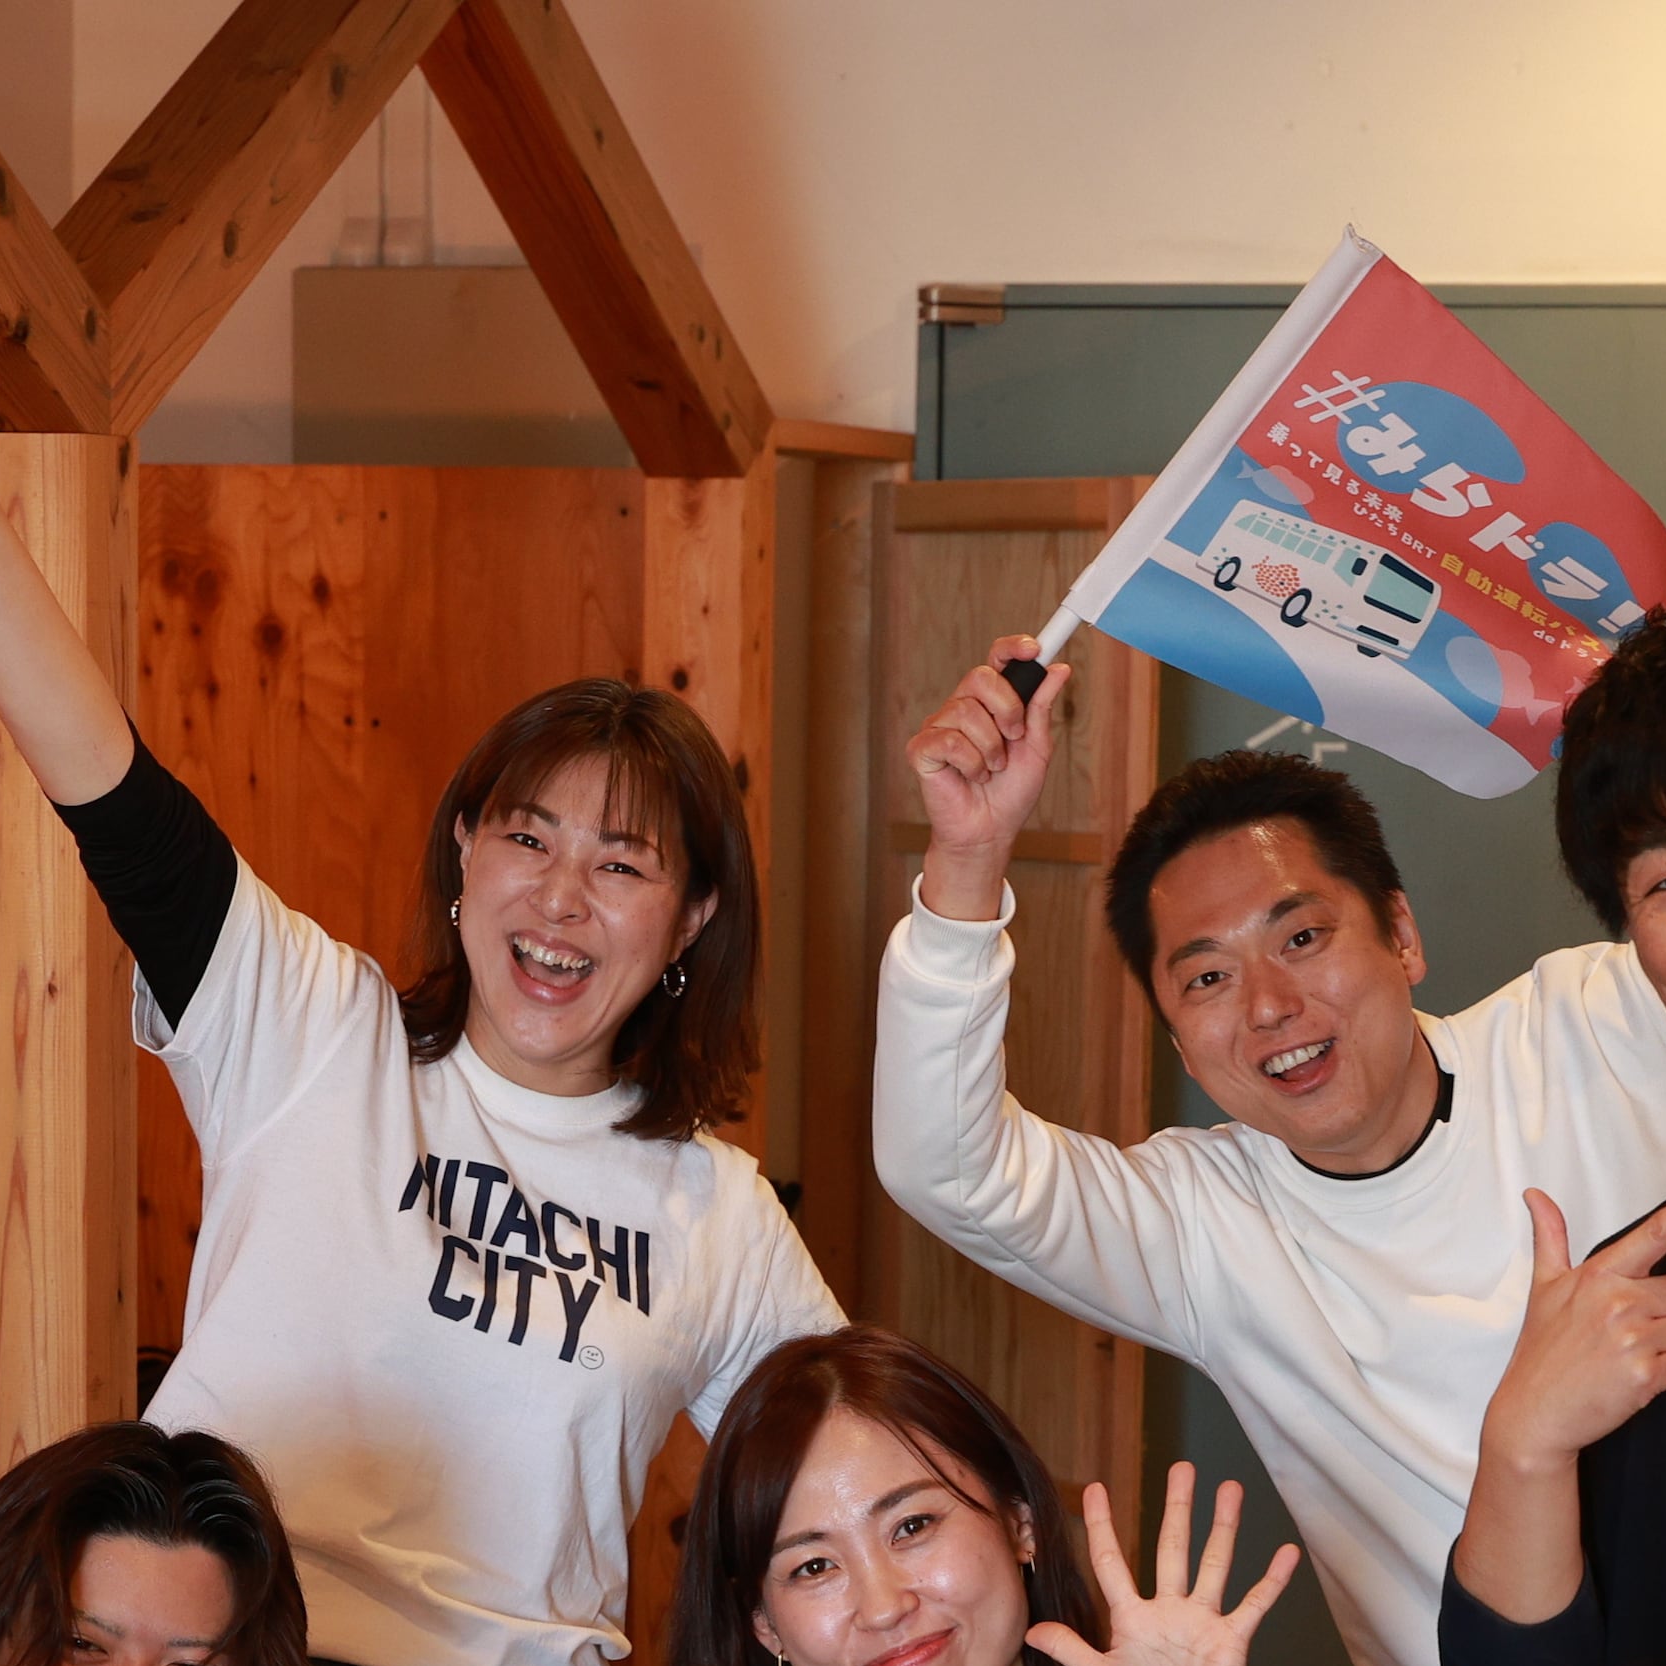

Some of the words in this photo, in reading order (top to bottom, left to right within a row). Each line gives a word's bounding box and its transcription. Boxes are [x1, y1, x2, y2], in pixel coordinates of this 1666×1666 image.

[1266, 421, 1404, 523] 乗って見る未来
[1293, 370, 1647, 634] #みらドラ!
[1440, 552, 1601, 652] 自動運転バス
[1532, 629, 1606, 667] deドライ
[398, 1153, 650, 1317] HITACHI
[428, 1234, 601, 1363] CITY
